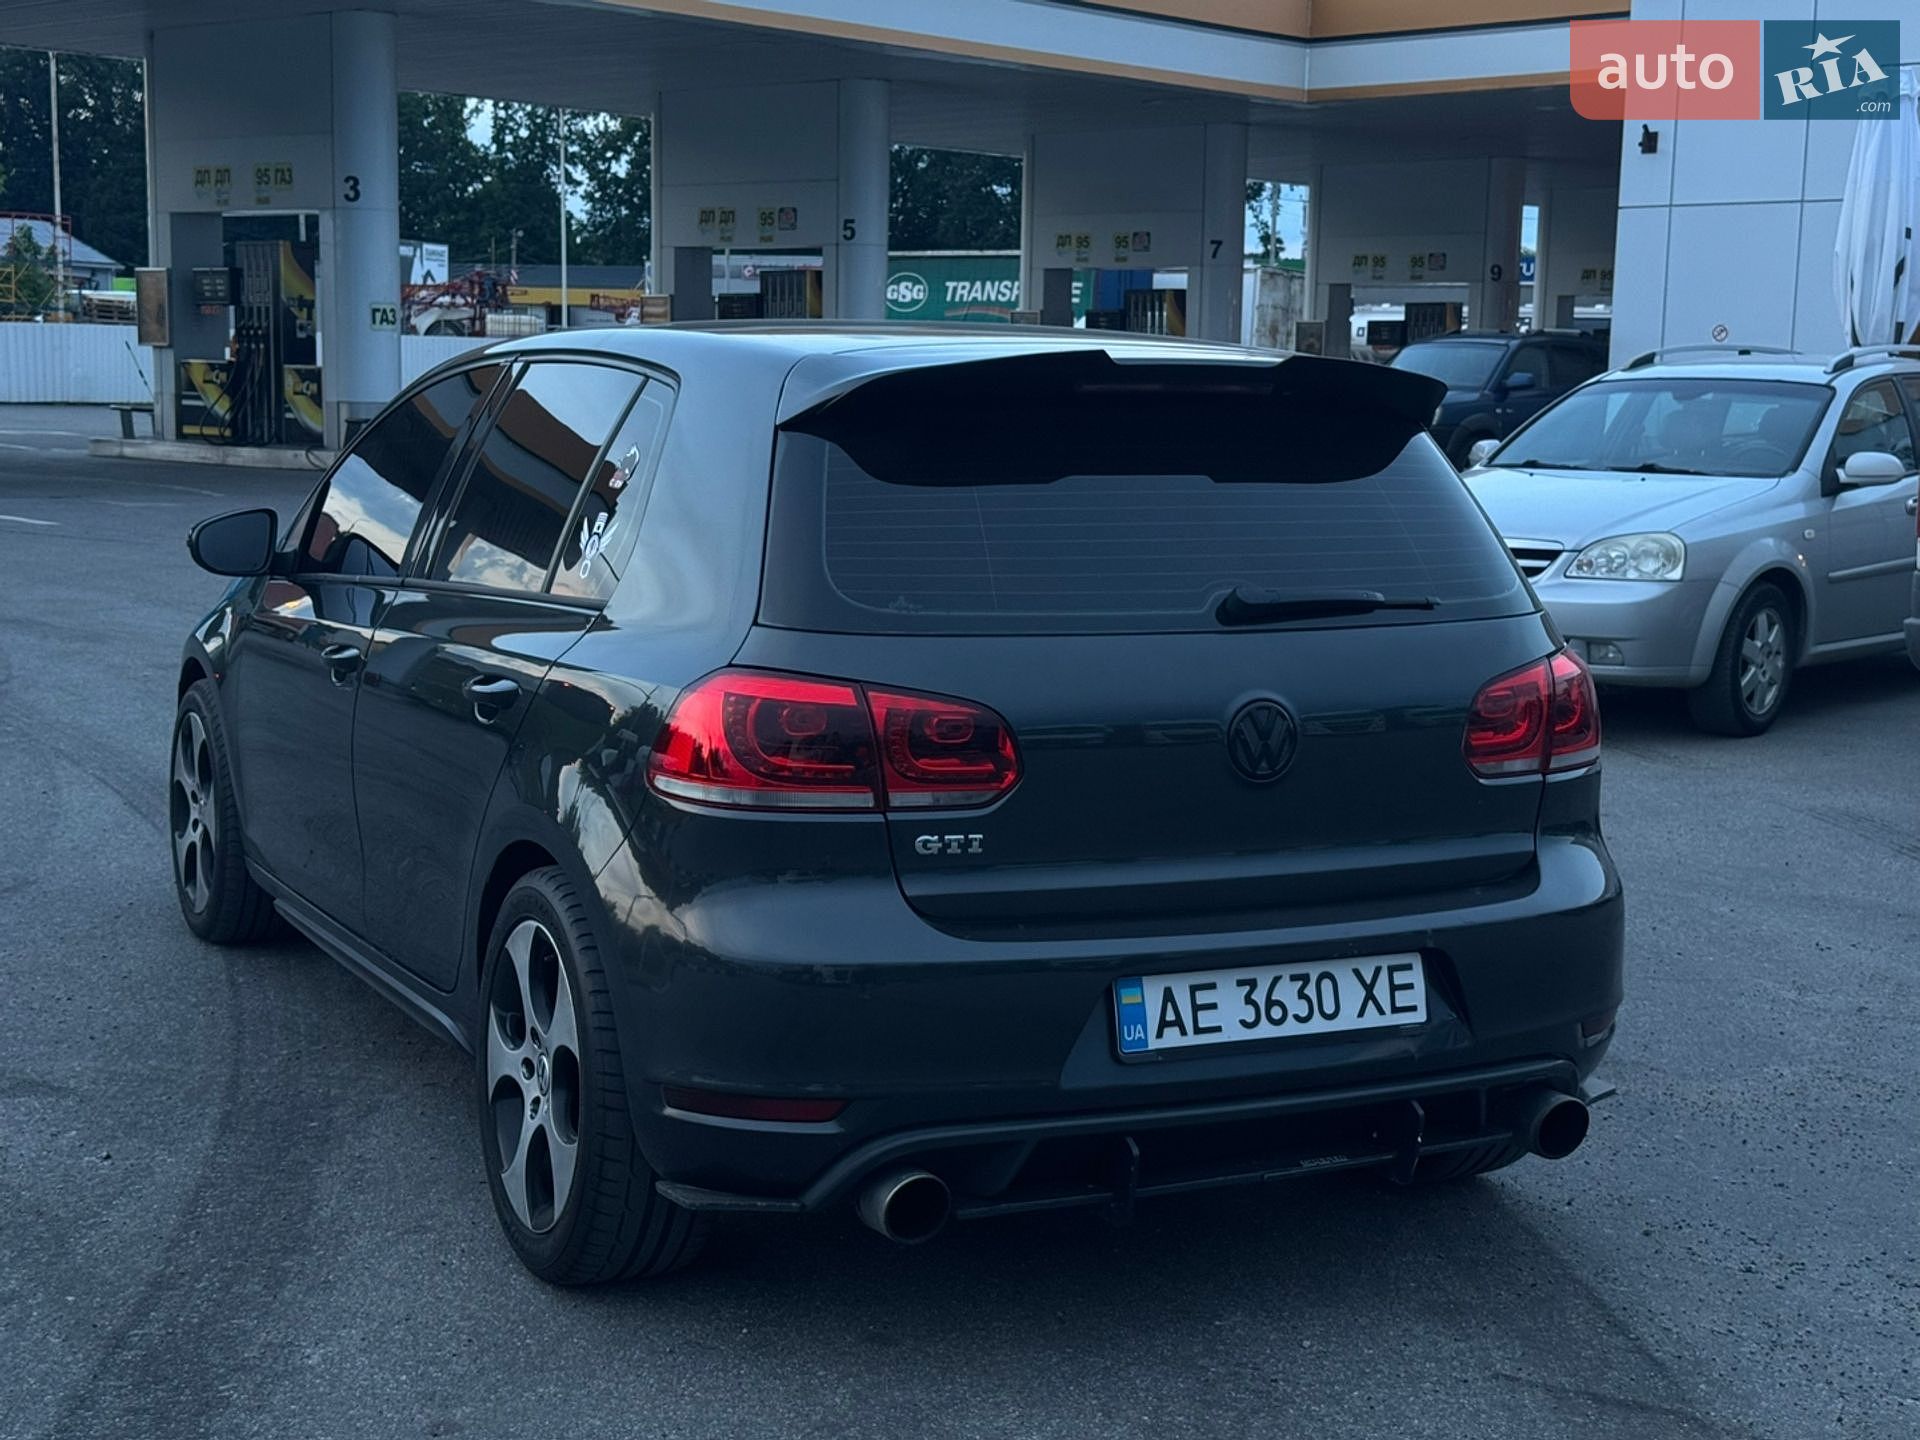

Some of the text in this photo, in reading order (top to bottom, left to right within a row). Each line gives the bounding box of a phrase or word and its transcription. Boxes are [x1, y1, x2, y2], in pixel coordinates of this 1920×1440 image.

[255, 167, 271, 185] 95
[274, 167, 293, 186] ГАЗ
[343, 175, 361, 202] 3
[760, 211, 775, 227] 95
[842, 218, 856, 241] 5
[1075, 235, 1090, 249] 95
[1114, 235, 1129, 249] 95
[1210, 239, 1223, 259] 7
[1372, 255, 1387, 268] 95
[1410, 256, 1425, 268] 95
[1489, 263, 1503, 281] 9
[886, 281, 924, 302] GSG
[371, 307, 397, 325] ГАЗ
[914, 834, 983, 855] GTI
[1155, 962, 1419, 1040] AE 3630 XE
[1123, 1023, 1145, 1041] UA
